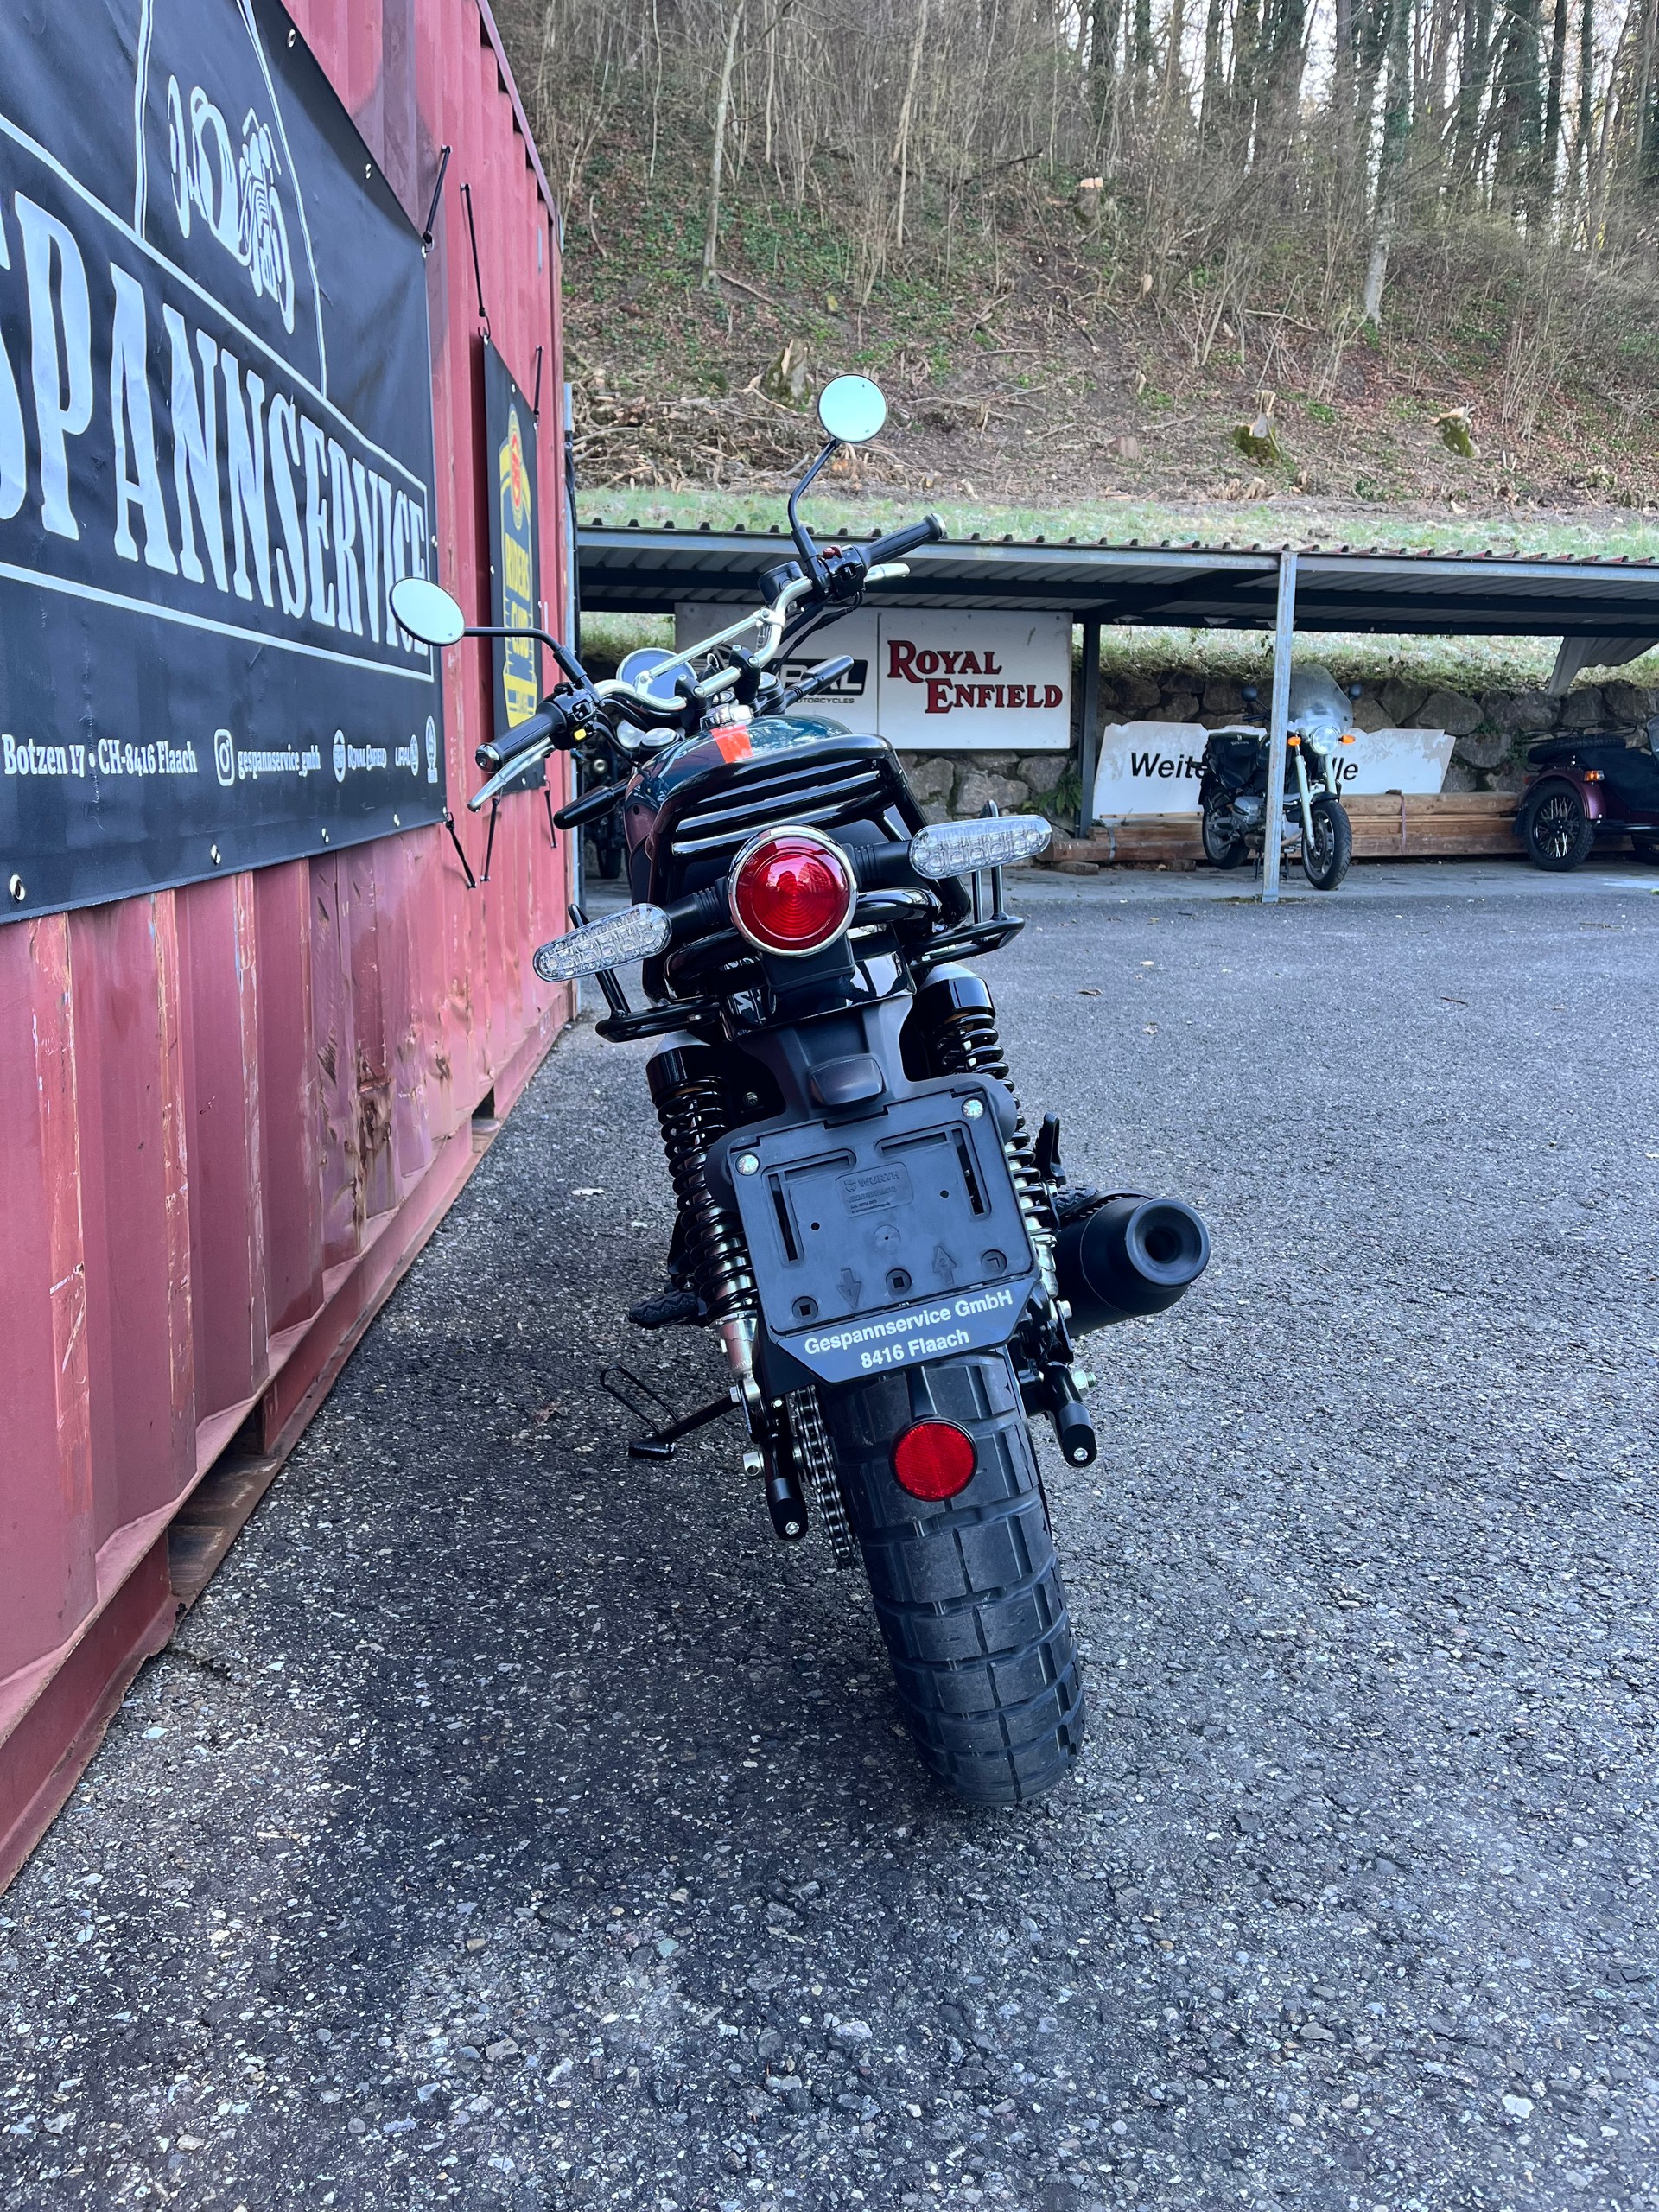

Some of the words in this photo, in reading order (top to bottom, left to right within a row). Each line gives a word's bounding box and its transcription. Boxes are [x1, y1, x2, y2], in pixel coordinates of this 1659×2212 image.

[505, 532, 530, 601] RIDERS
[887, 640, 1002, 683] ROYAL
[925, 678, 1064, 714] ENFIELD
[2, 734, 68, 775] Botzen
[69, 744, 85, 778] 17
[97, 738, 156, 777] CH-8416
[156, 740, 198, 773] Flaach
[1130, 752, 1208, 779] Weite
[804, 1308, 952, 1355] Gespannservice
[954, 1289, 1014, 1318] GmbH
[861, 1345, 905, 1369] 8416
[907, 1329, 970, 1357] Flaach
